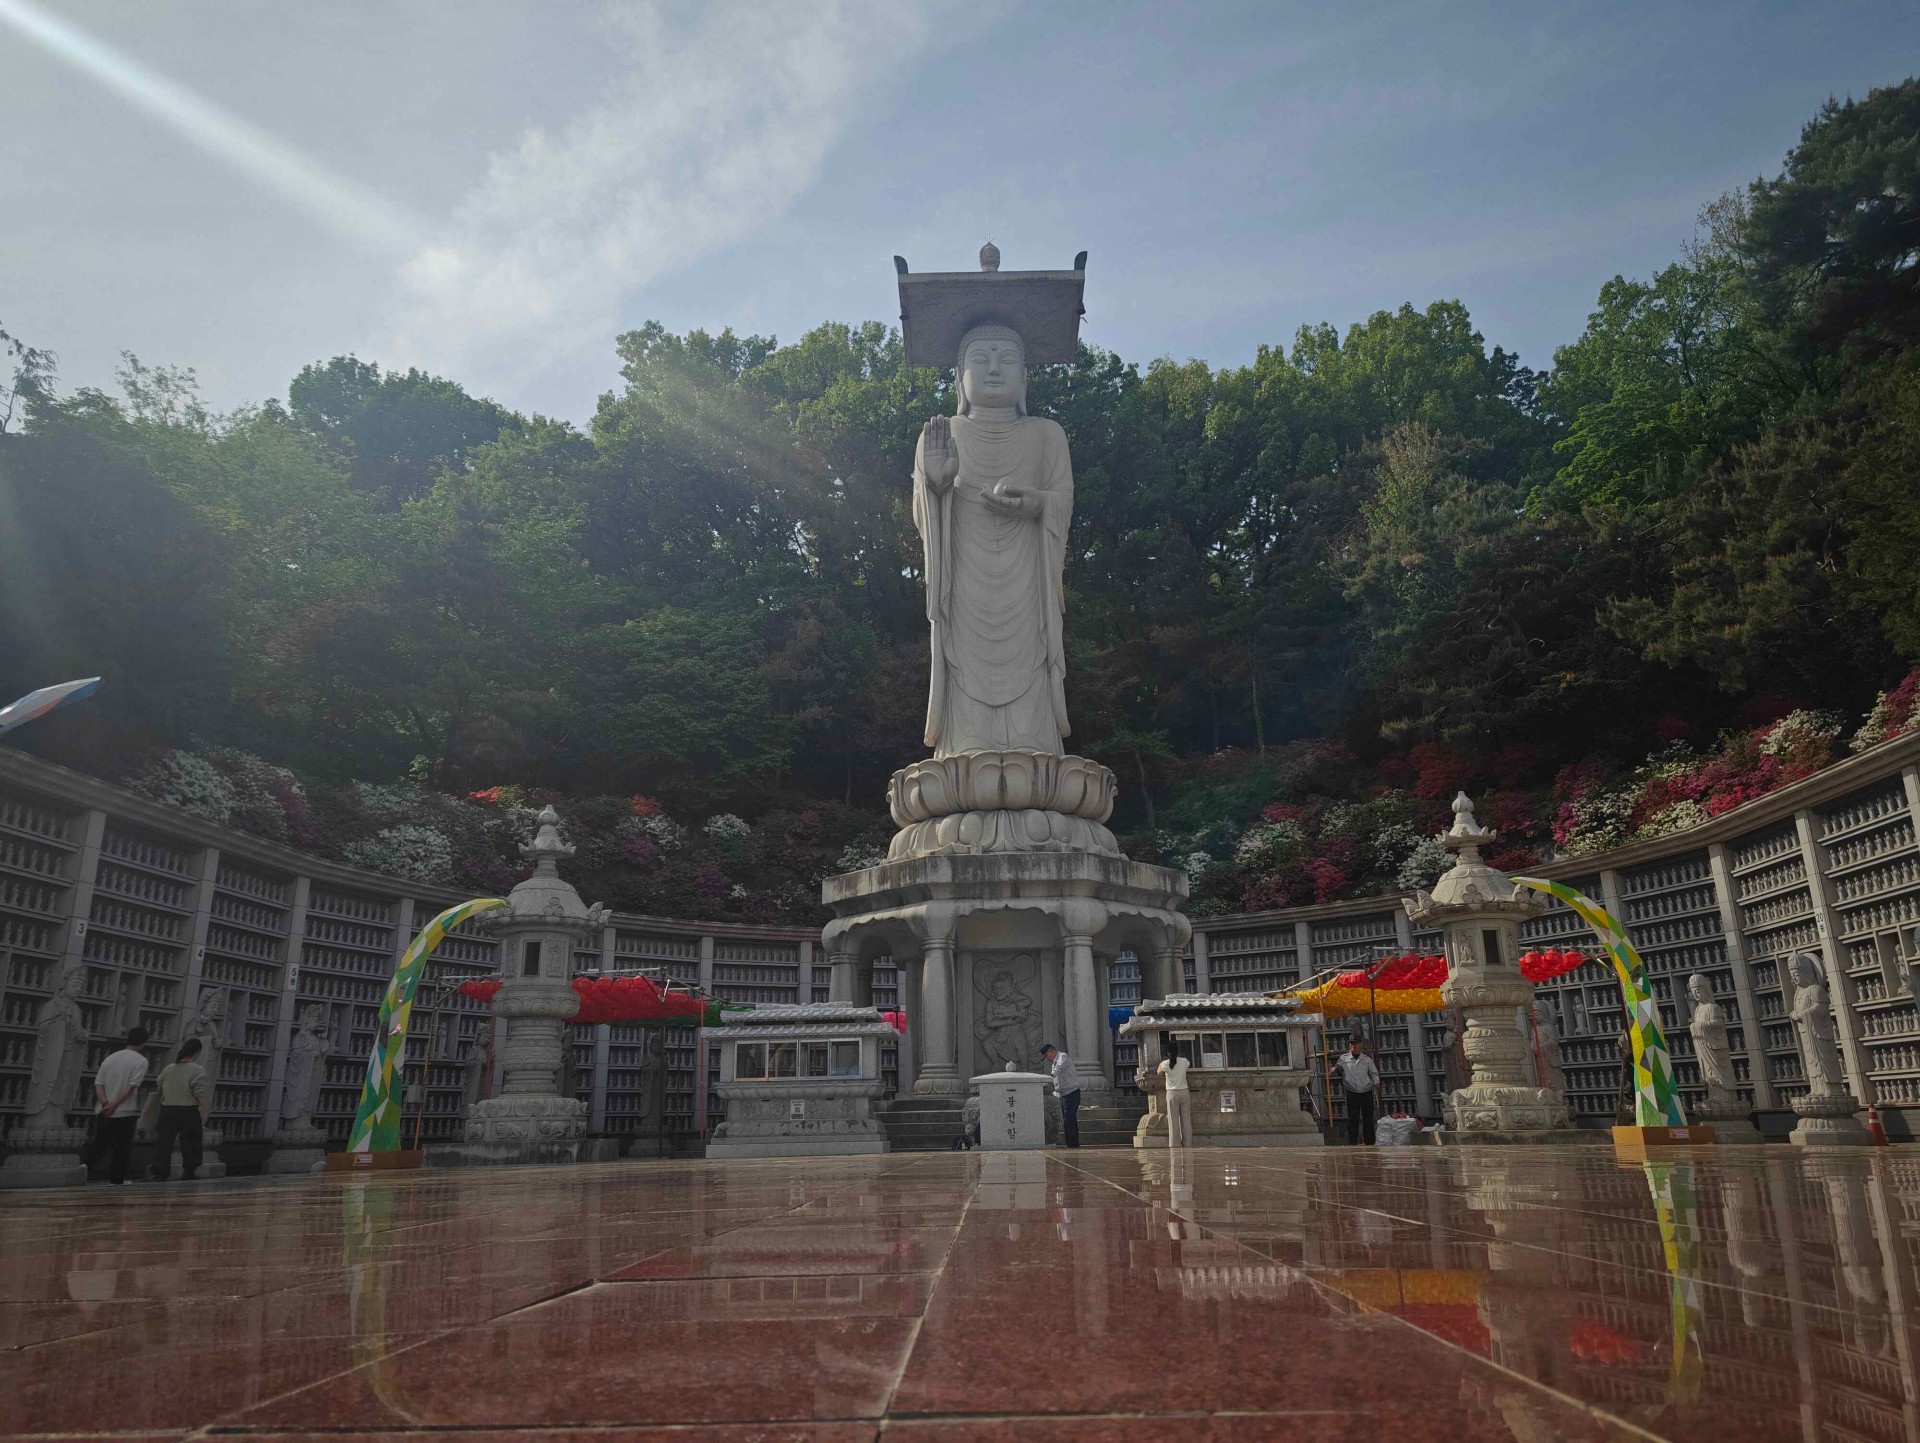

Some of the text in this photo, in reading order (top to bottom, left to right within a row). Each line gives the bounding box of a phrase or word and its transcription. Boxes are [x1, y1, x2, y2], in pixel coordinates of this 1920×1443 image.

[1816, 913, 1824, 923] 20
[78, 923, 85, 934] 3
[197, 948, 203, 958] 4
[291, 967, 297, 977] 5
[1006, 1095, 1018, 1140] 불전함
